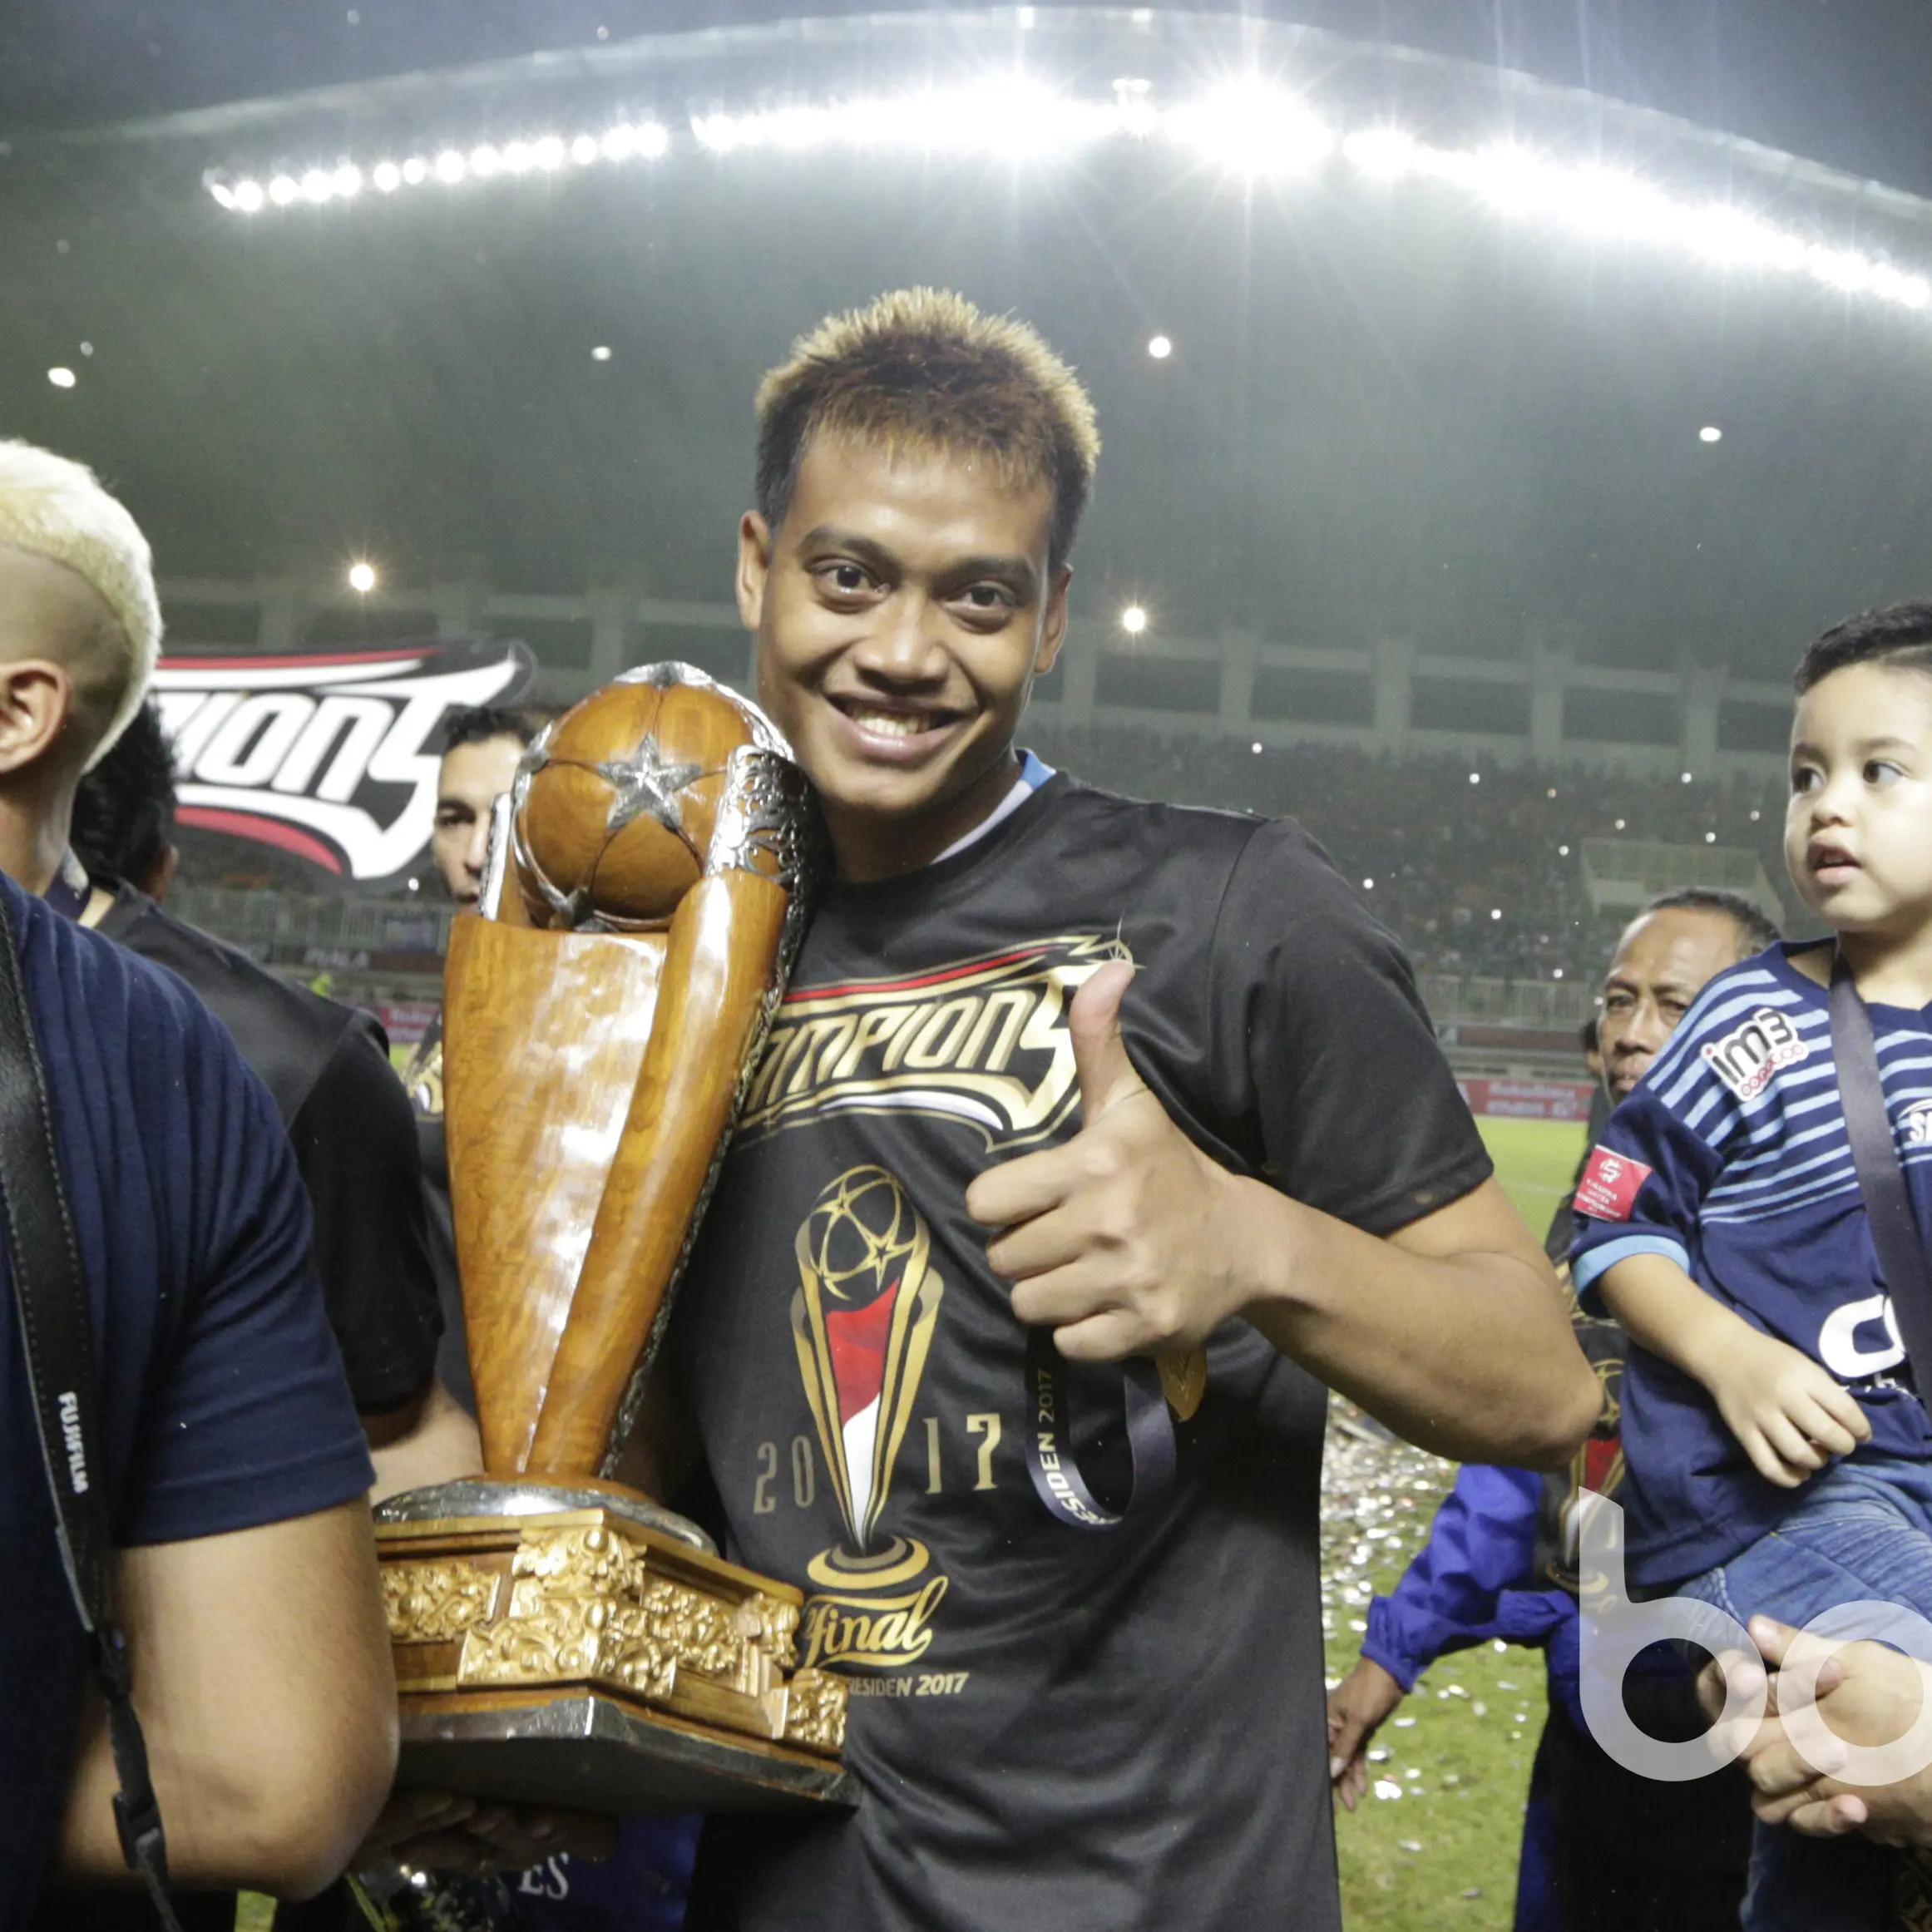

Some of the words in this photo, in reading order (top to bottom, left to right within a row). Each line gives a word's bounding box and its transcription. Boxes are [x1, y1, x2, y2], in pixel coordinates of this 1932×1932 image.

[1038, 1367, 1055, 1424] 2017
[57, 1390, 89, 1494] FUJIFILM
[804, 1575, 949, 1668] final
[848, 1676, 913, 1698] RESIDEN
[916, 1672, 970, 1697] 2017
